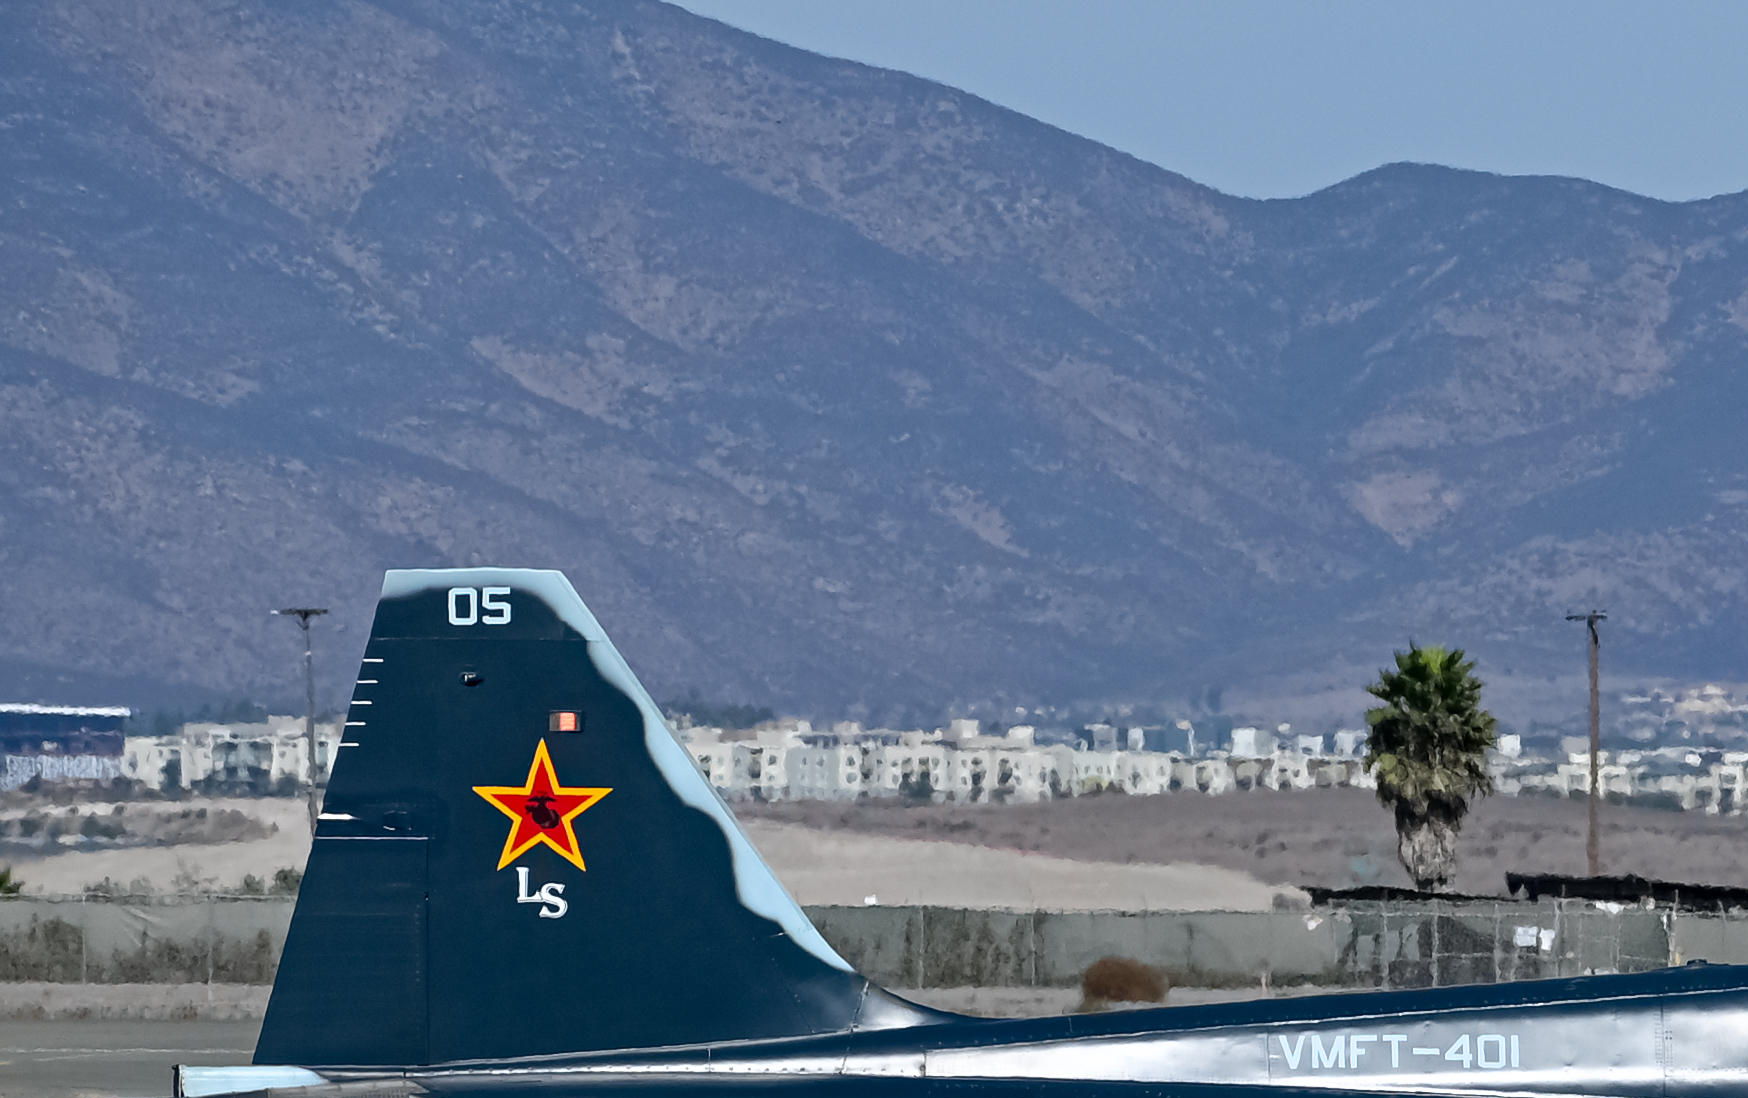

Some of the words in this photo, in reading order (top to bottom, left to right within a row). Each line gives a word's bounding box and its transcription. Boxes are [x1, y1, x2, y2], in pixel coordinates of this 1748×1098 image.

[447, 586, 511, 626] 05
[515, 866, 568, 918] LS
[1278, 1034, 1520, 1070] VMFT-401
